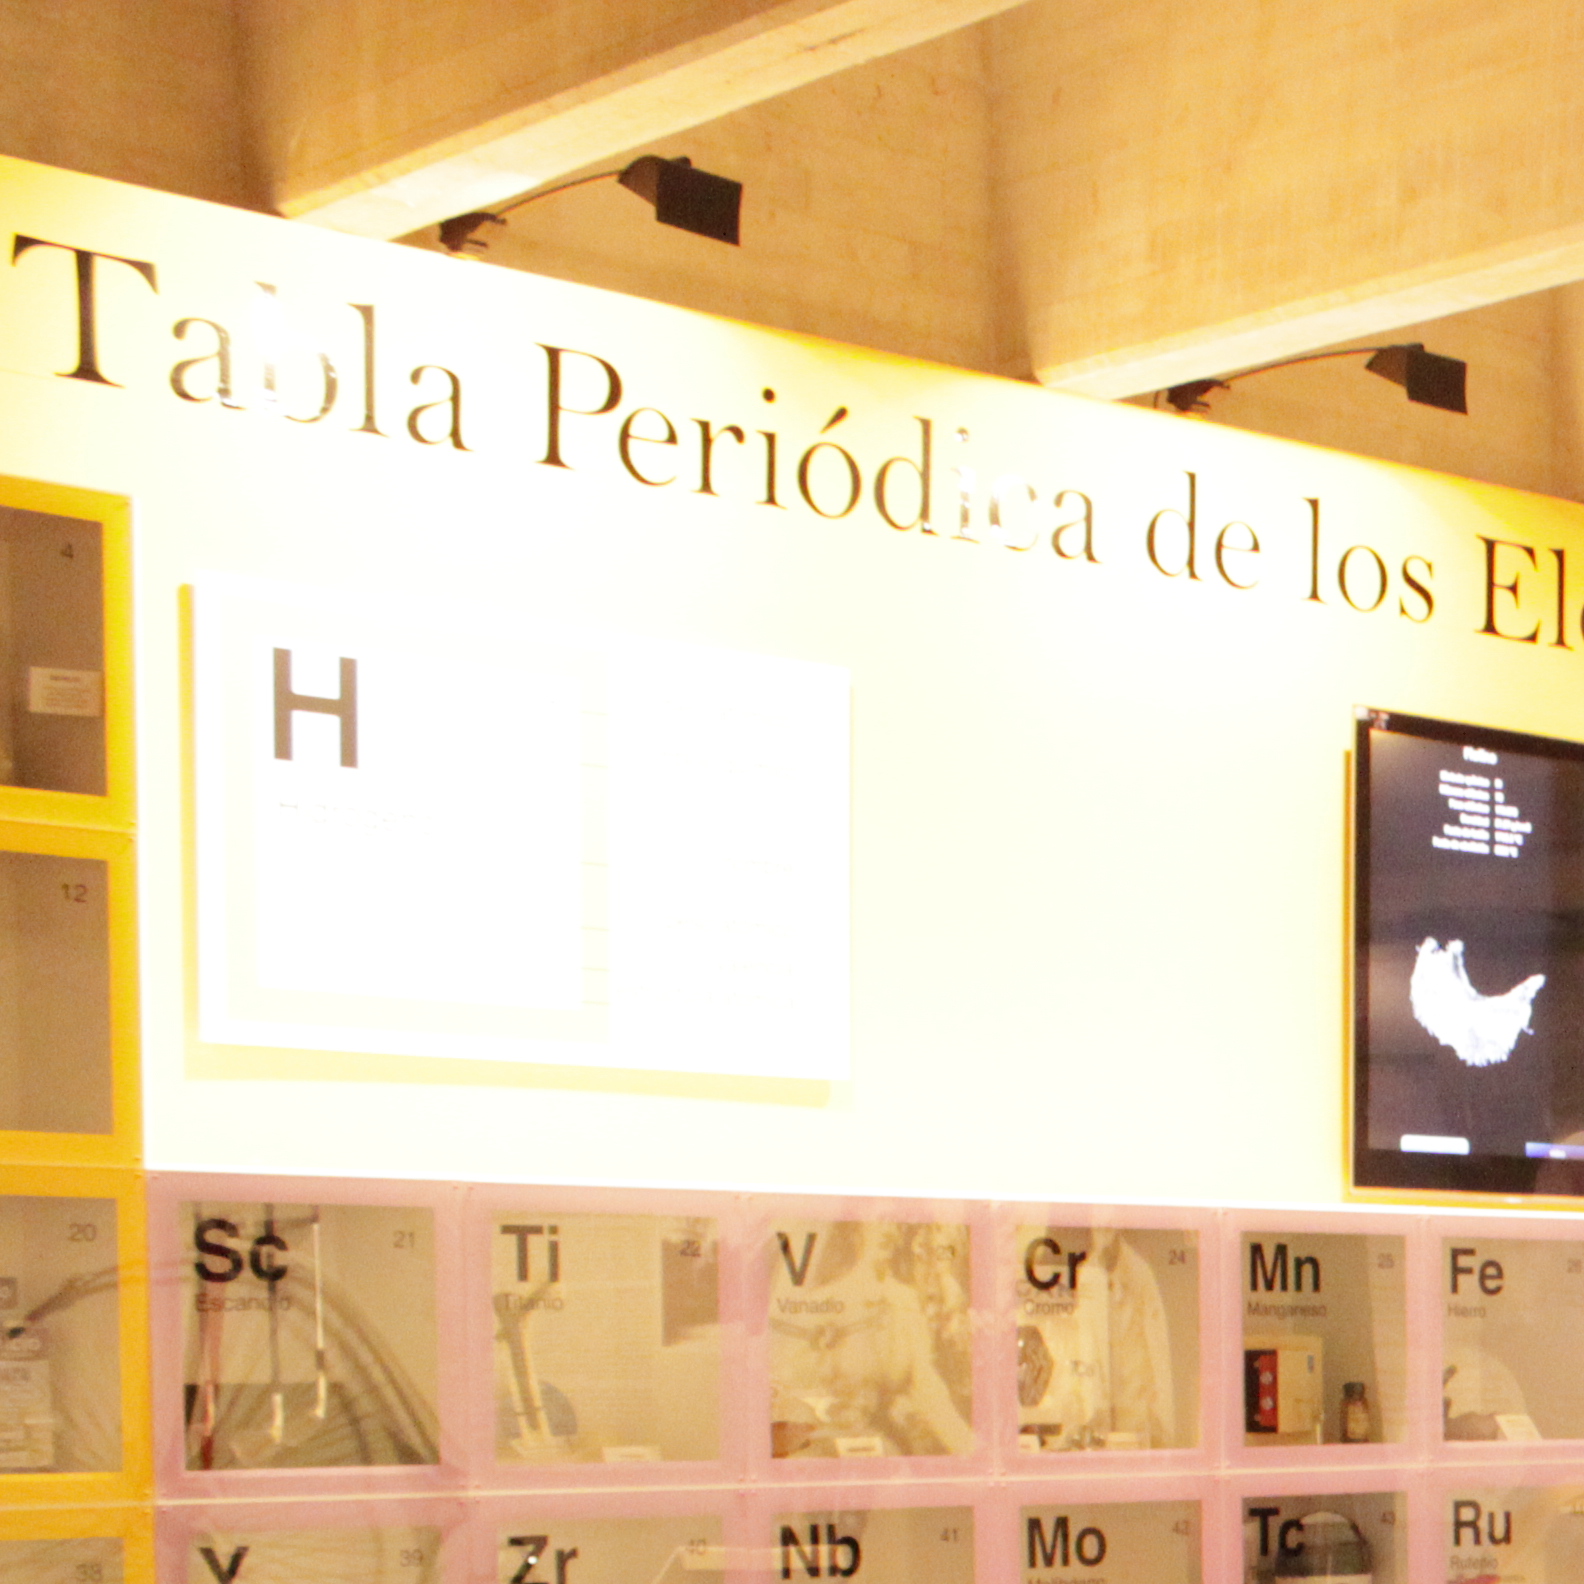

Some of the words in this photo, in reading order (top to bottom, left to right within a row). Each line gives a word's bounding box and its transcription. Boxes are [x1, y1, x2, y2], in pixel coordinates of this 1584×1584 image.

[12, 234, 474, 452] Tabla
[534, 342, 1102, 564] Periódica
[1145, 471, 1263, 590] de
[1303, 496, 1437, 626] los
[272, 647, 359, 769] H
[67, 1224, 97, 1243] 20
[192, 1218, 290, 1283] Sc
[393, 1231, 416, 1249] 21
[500, 1224, 560, 1282] Ti
[776, 1232, 817, 1287] V
[1023, 1236, 1087, 1292] Cr
[1249, 1242, 1321, 1294] Mn
[1449, 1247, 1505, 1296] Fe
[777, 1299, 845, 1315] Vanadio
[1248, 1303, 1328, 1320] Manganeso
[1447, 1303, 1487, 1319] Hierro
[1026, 1515, 1107, 1571] Mo
[1248, 1506, 1306, 1558] Tc
[1452, 1499, 1513, 1548] Ru
[779, 1524, 861, 1580] Nb
